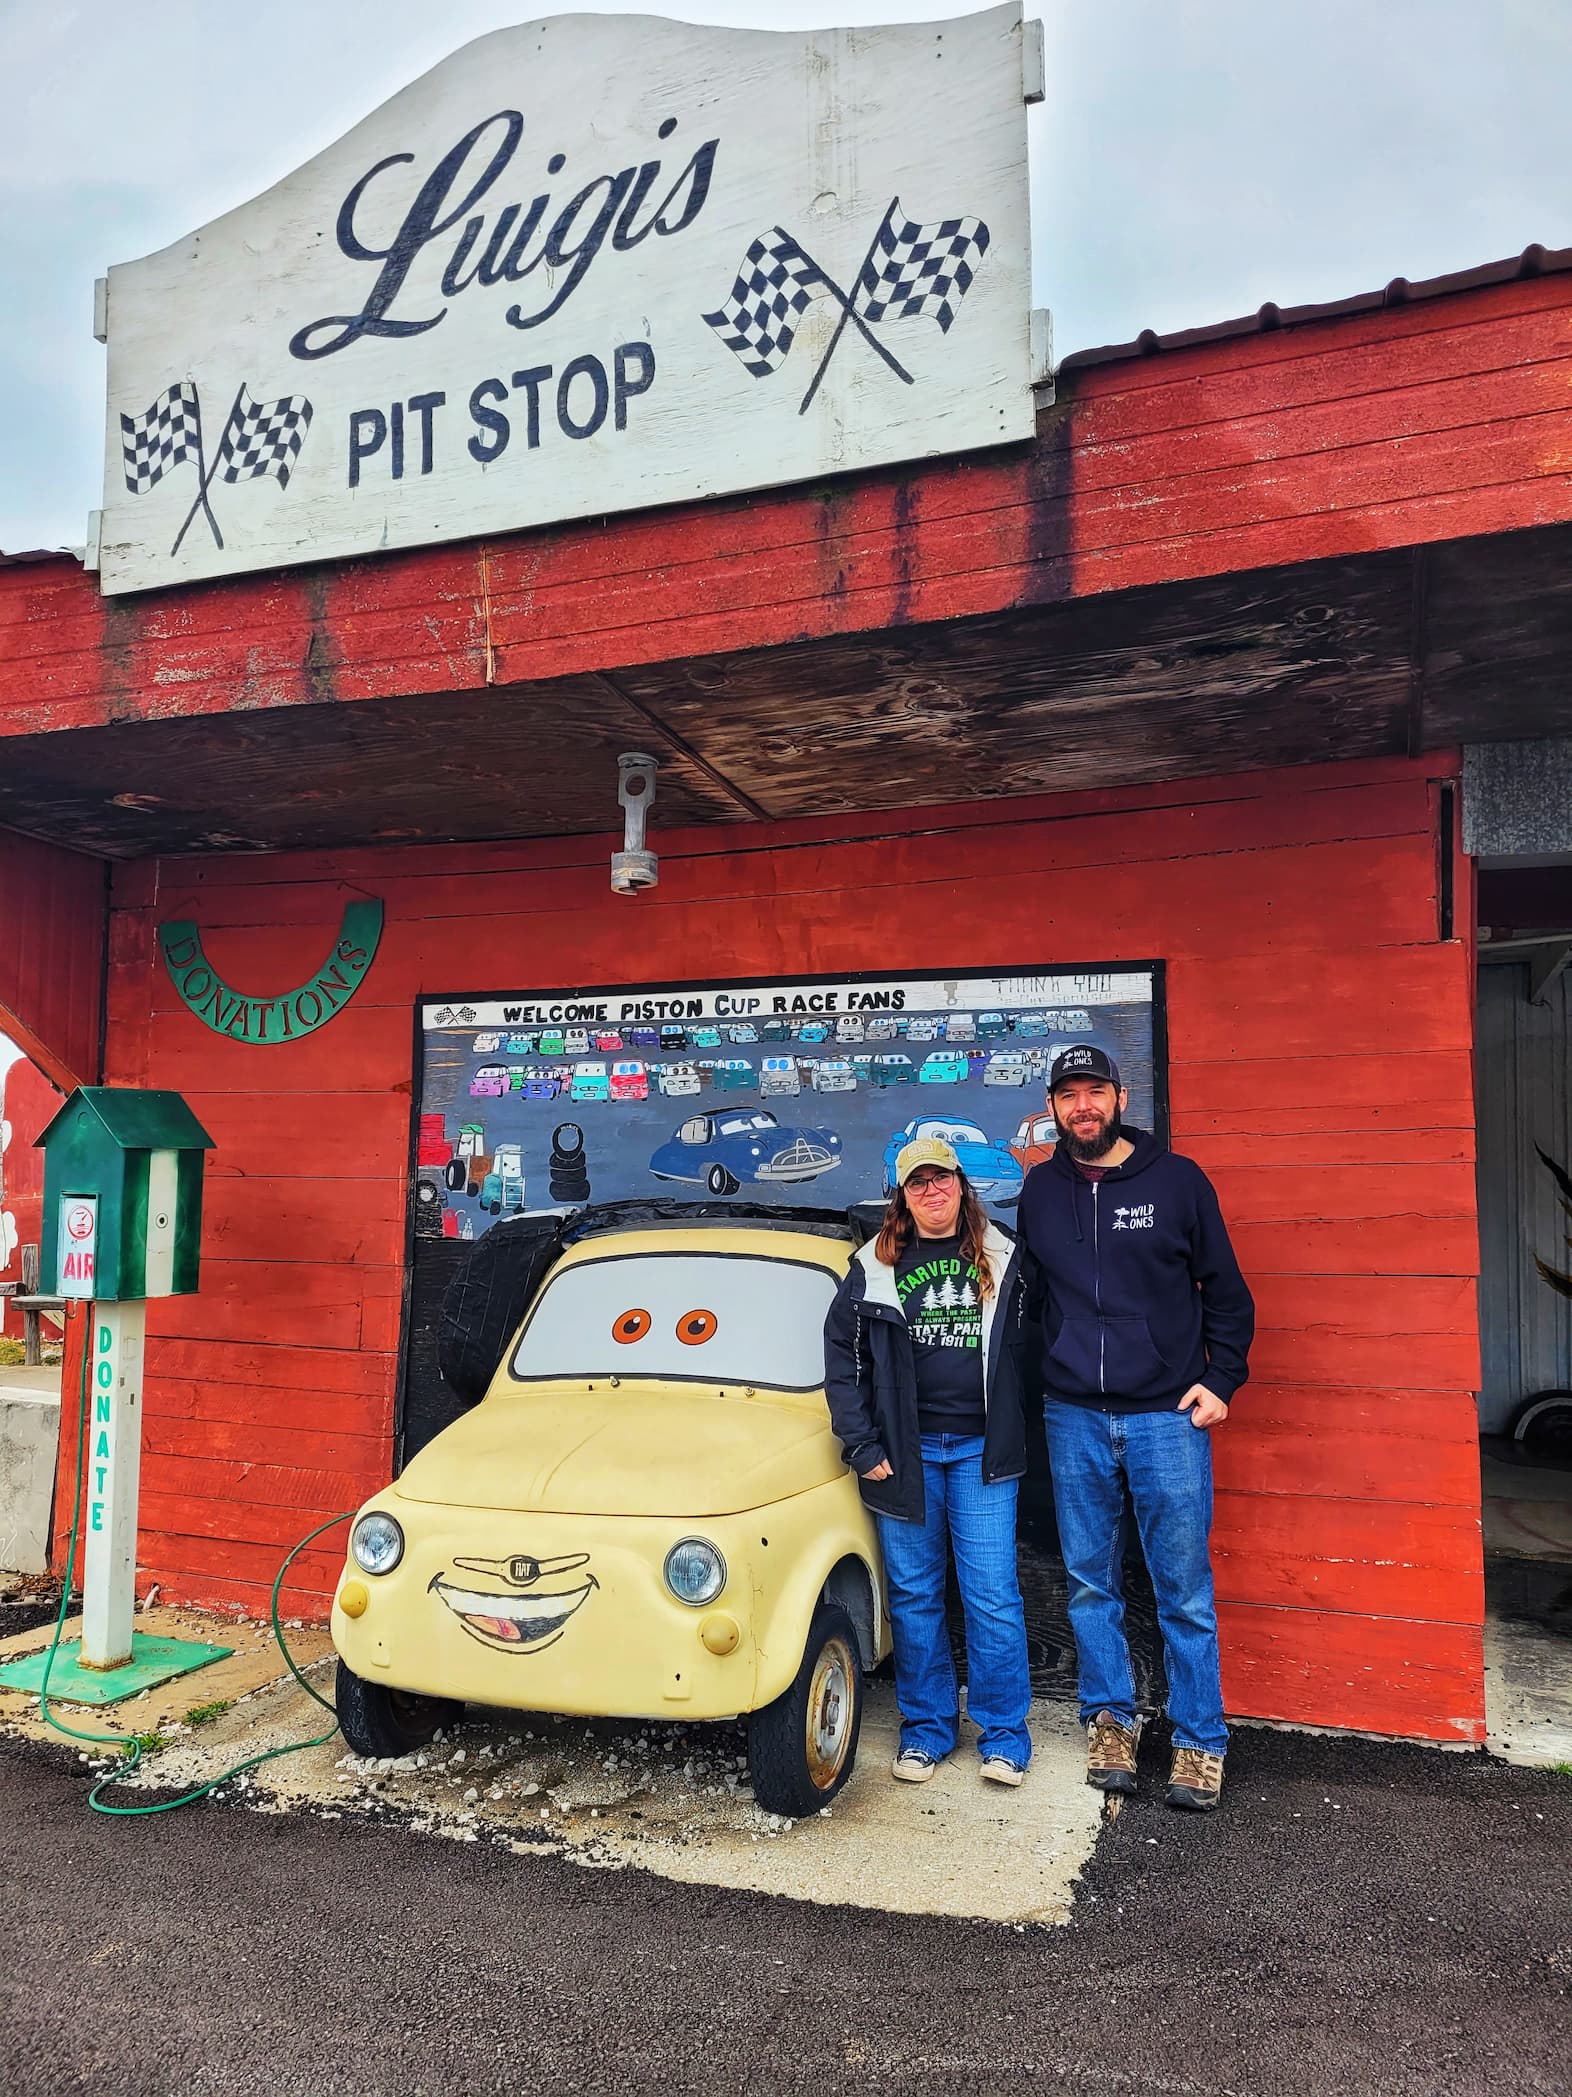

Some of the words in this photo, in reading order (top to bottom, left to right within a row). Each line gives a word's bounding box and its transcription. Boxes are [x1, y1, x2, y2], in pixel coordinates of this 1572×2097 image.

[347, 391, 446, 489] PIT
[467, 340, 656, 464] STOP
[166, 936, 368, 1039] DONATIONS
[503, 1003, 608, 1023] WELCOME
[620, 998, 704, 1021] PISTON
[773, 992, 837, 1013] RACE
[847, 989, 906, 1011] FANS
[1073, 1049, 1092, 1059] WILD
[1073, 1058, 1093, 1066] ONES
[1130, 1203, 1155, 1218] WILD
[1129, 1216, 1154, 1230] ONES
[63, 1252, 95, 1281] AIR
[960, 1308, 977, 1316] PAST
[925, 1316, 951, 1324] ALWAYS
[953, 1322, 983, 1335] PAR
[940, 1334, 965, 1348] 1911
[91, 1325, 113, 1532] DONATE
